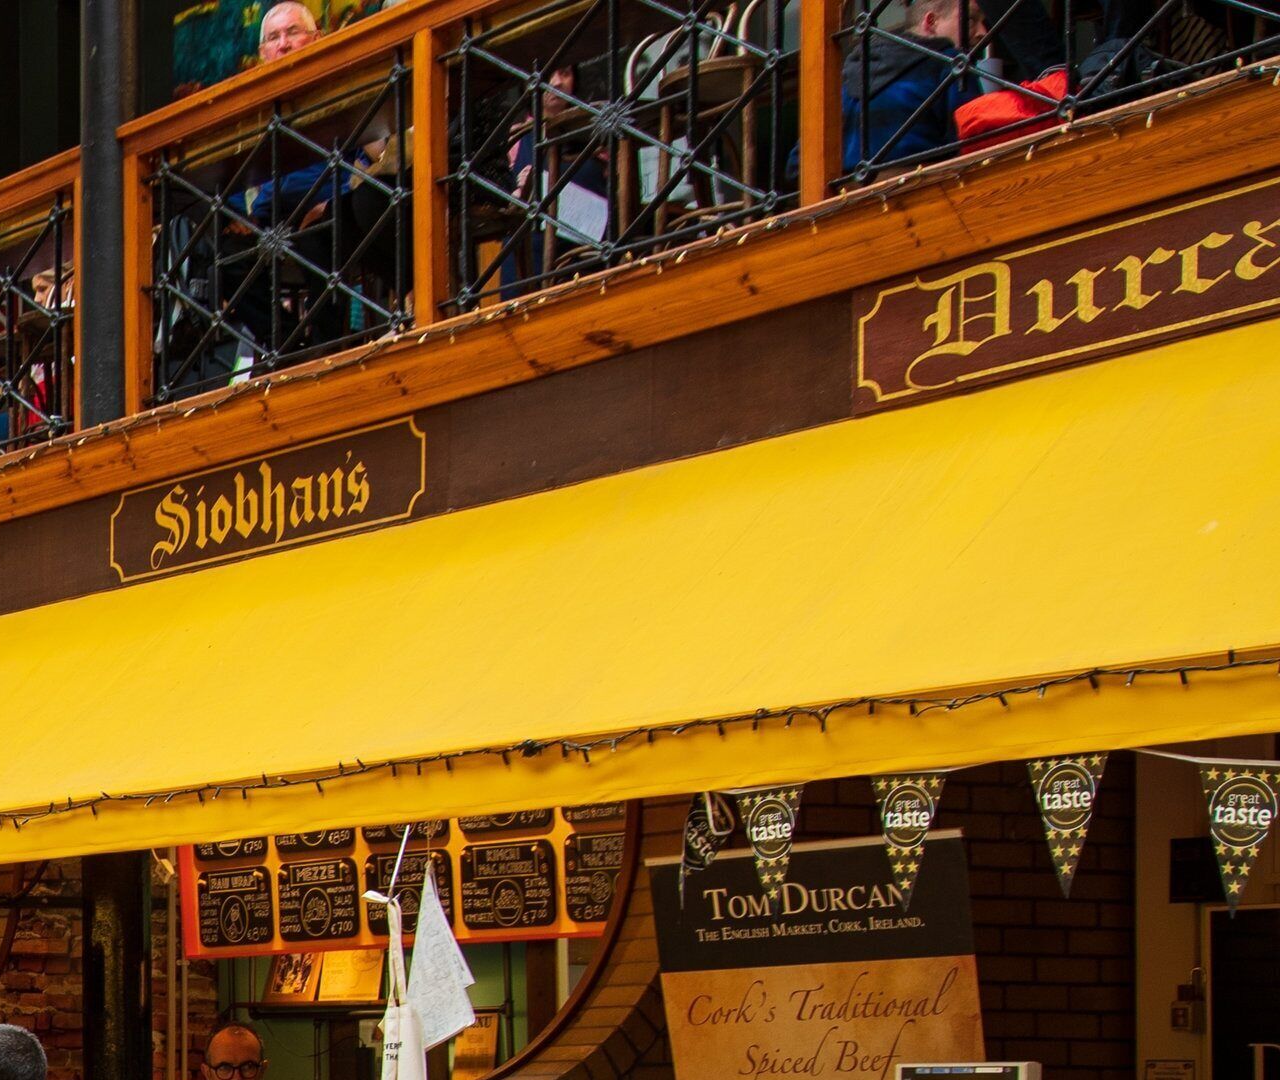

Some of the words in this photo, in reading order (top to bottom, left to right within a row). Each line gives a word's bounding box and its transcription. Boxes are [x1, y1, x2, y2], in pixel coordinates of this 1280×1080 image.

[151, 450, 370, 570] Siobhan's
[1052, 777, 1081, 794] great
[894, 798, 919, 814] great
[1042, 788, 1092, 810] taste
[1228, 791, 1260, 808] great
[760, 812, 782, 826] great
[885, 807, 931, 829] taste
[1214, 803, 1272, 826] taste
[752, 822, 792, 842] taste
[296, 864, 335, 882] MEZZE
[703, 888, 772, 921] TOM
[781, 882, 904, 915] DURCAN
[696, 928, 719, 942] THE
[721, 926, 770, 940] ENGLISH
[687, 980, 776, 1026] Cork's
[788, 966, 959, 1023] Traditional
